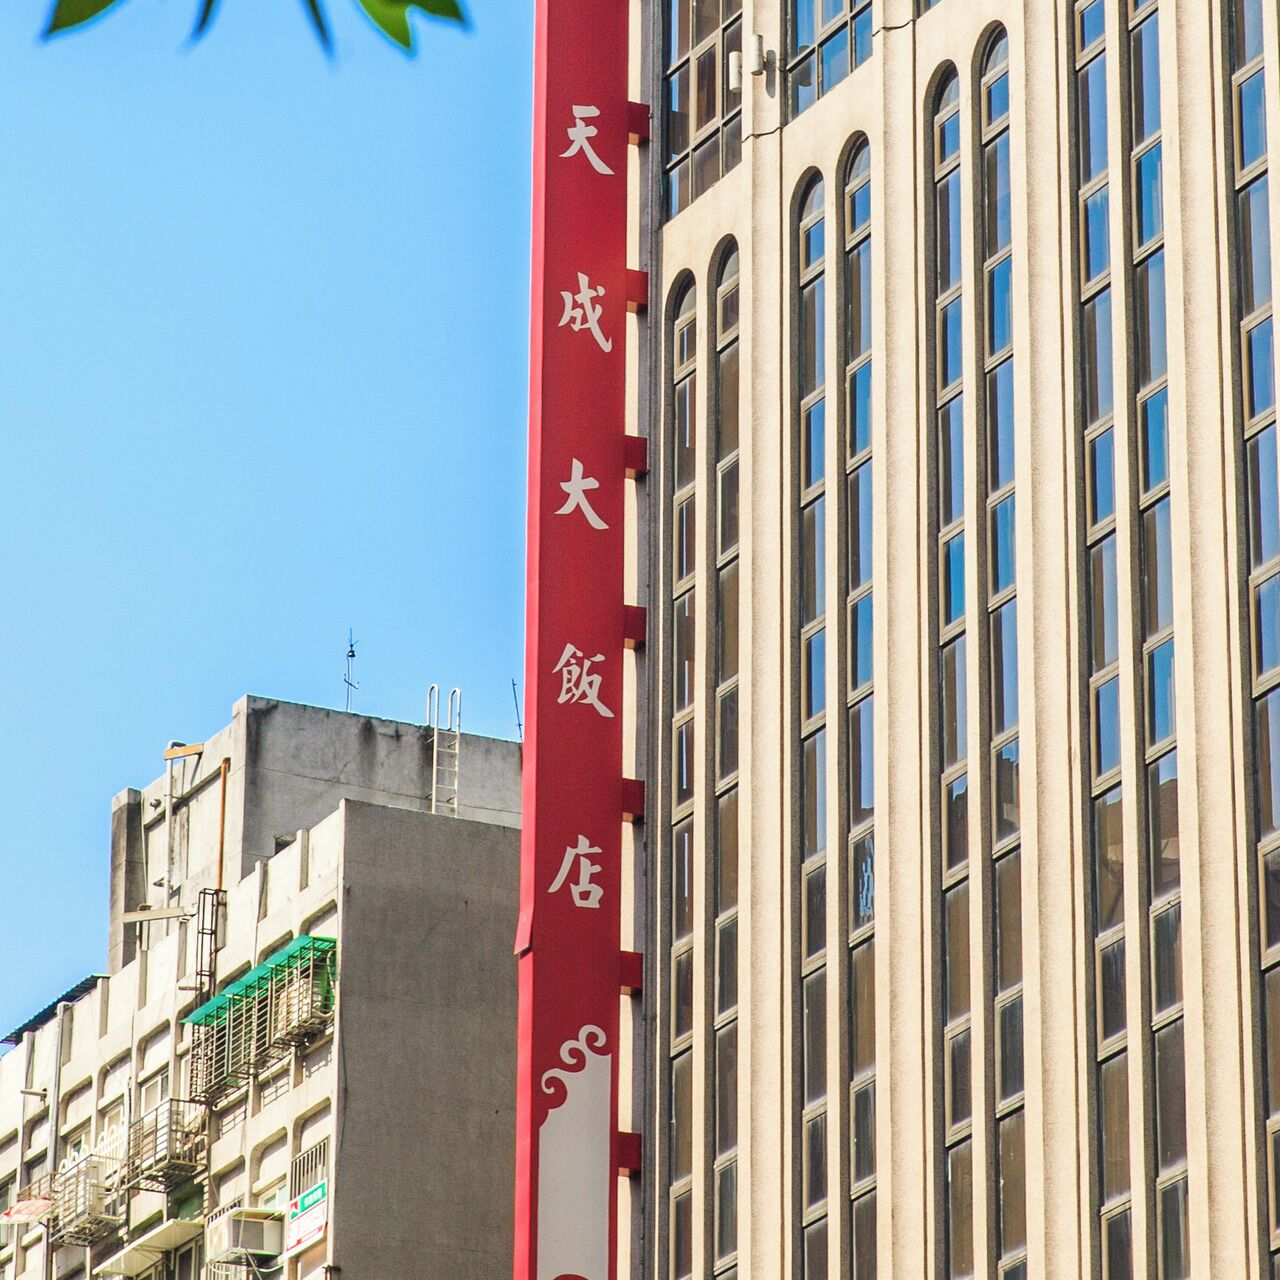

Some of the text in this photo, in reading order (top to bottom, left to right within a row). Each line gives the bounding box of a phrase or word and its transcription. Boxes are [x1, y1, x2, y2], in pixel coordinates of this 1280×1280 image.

[549, 104, 615, 908] 天成大飯店
